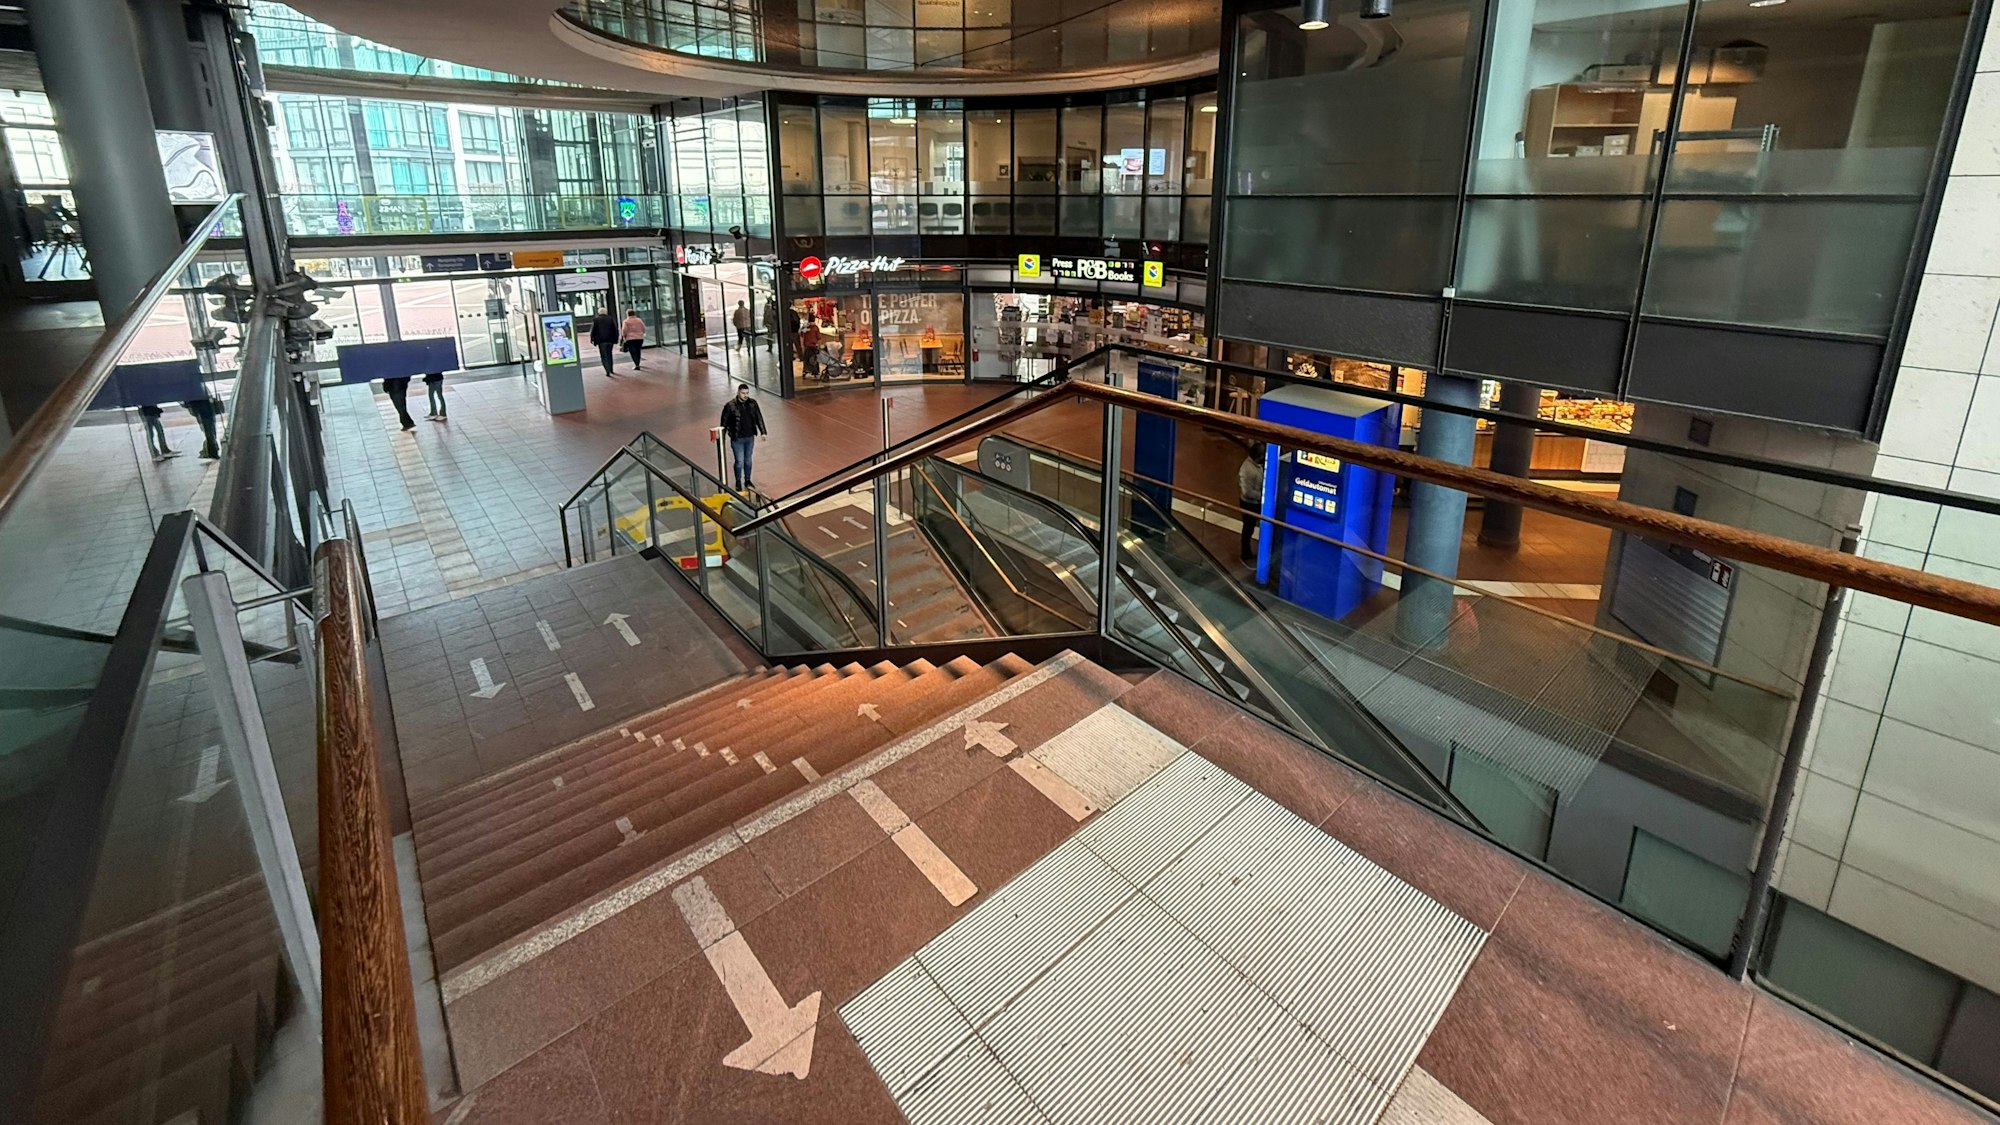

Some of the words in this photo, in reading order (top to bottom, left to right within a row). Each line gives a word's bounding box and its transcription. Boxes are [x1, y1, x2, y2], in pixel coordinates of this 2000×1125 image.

[824, 256, 870, 276] Pizza
[870, 255, 905, 272] Hut
[1052, 257, 1073, 268] Press
[1107, 270, 1134, 282] Books
[890, 292, 937, 309] POWER
[1295, 477, 1337, 495] Geldautomat
